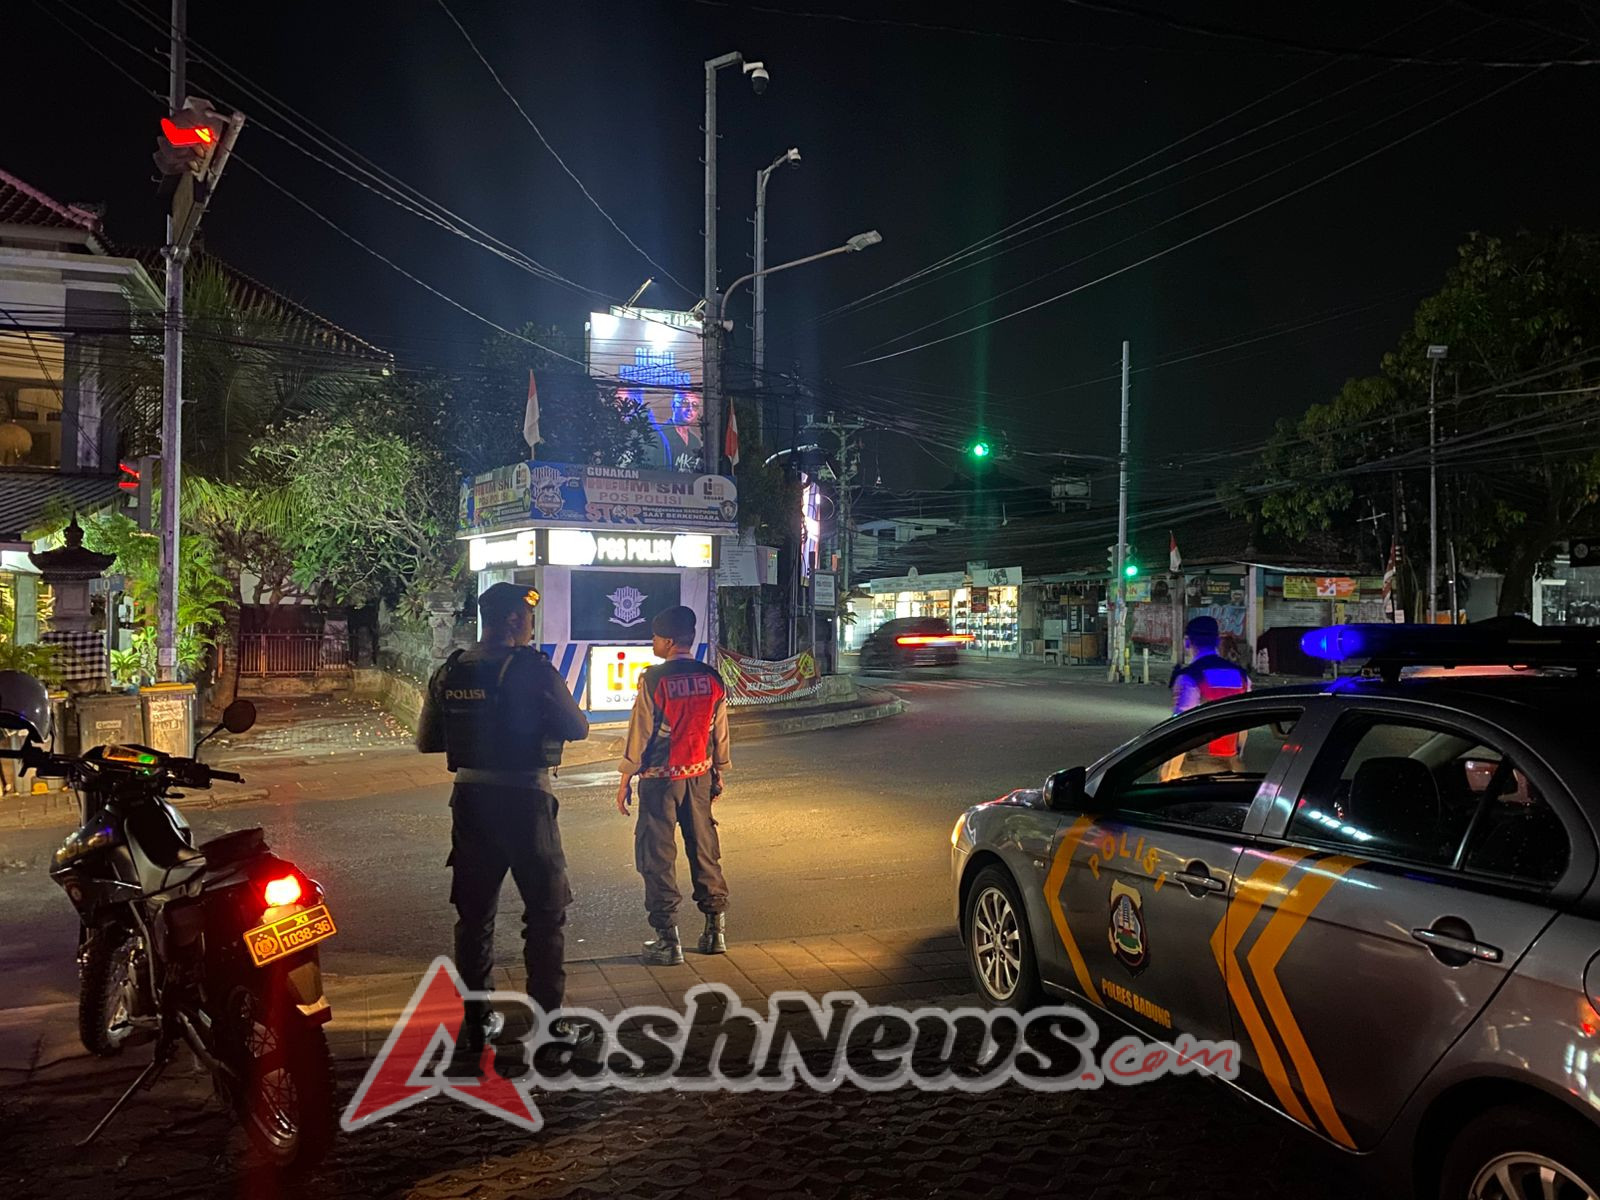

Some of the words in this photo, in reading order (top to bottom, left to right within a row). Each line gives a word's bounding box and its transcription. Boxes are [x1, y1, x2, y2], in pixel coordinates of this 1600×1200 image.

[586, 467, 640, 479] GUNAKAN
[587, 478, 650, 493] HELM
[656, 483, 695, 496] SNI
[599, 492, 629, 503] POS
[634, 493, 682, 505] POLISI
[642, 511, 664, 519] SAAT
[665, 512, 720, 522] BERKENDARA
[597, 537, 627, 560] POS
[445, 689, 486, 700] POLISI
[668, 677, 711, 698] POLISI
[282, 920, 331, 948] 1038-36
[1101, 977, 1133, 1009] POLRES
[1132, 993, 1173, 1029] BADUNG
